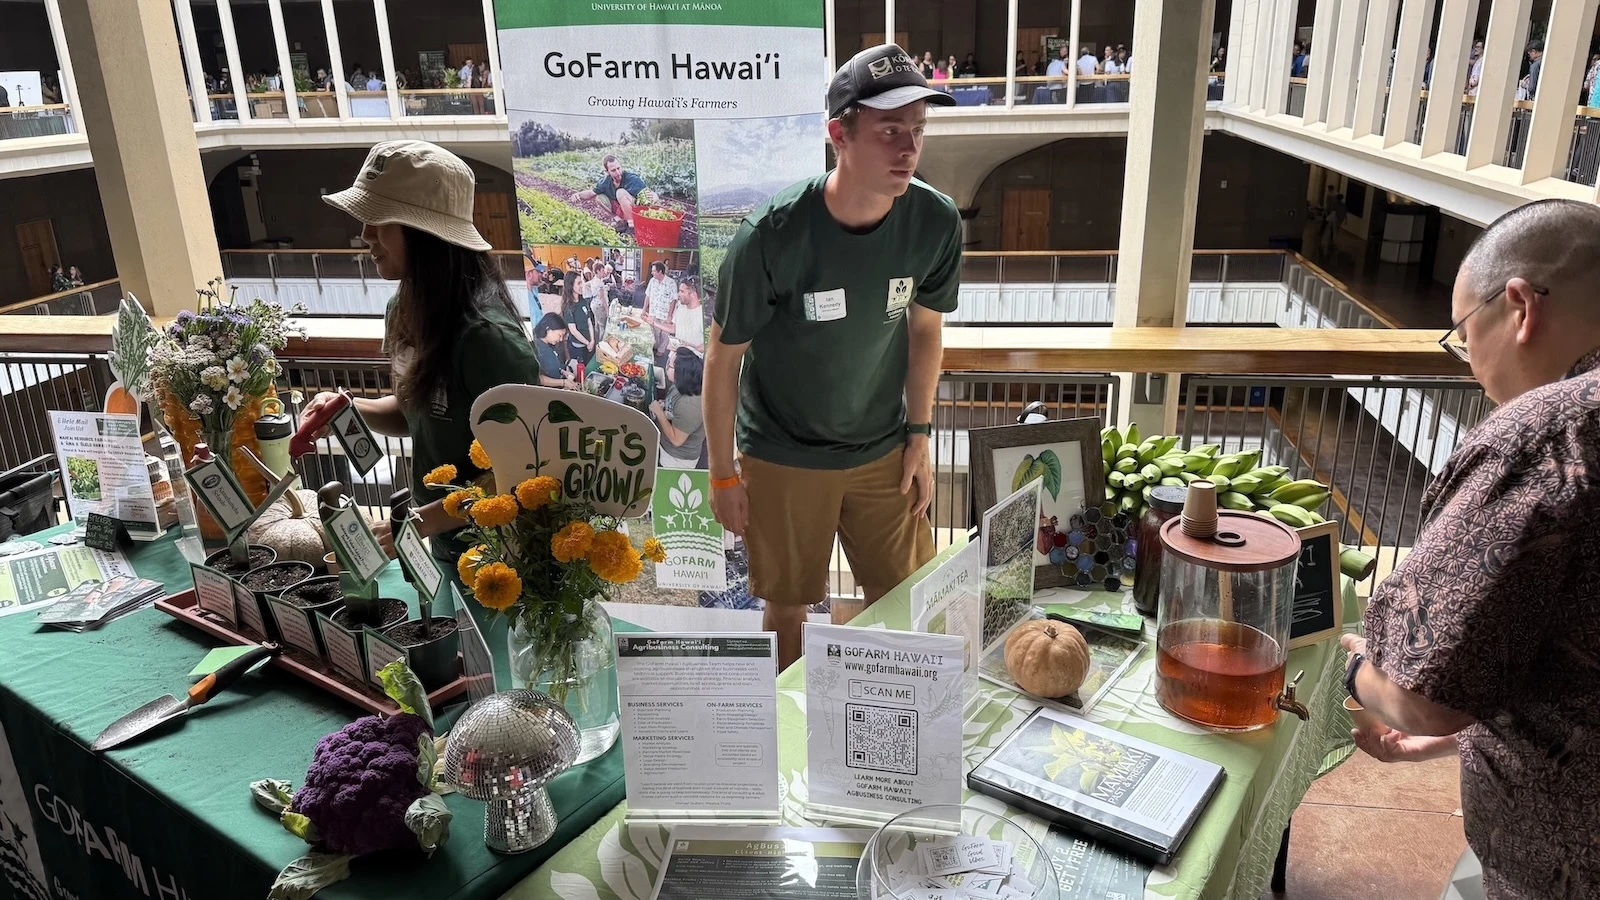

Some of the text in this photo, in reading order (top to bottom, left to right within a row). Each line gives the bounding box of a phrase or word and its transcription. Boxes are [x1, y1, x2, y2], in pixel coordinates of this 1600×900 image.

[544, 52, 780, 80] GoFarm Hawai'i
[588, 96, 634, 110] Growing
[690, 98, 738, 109] Farmers
[559, 424, 646, 466] LET'S
[564, 462, 645, 509] GROW!
[664, 556, 716, 569] GOFARM
[674, 570, 708, 579] HAWAI'I
[956, 570, 968, 586] TEA
[844, 647, 943, 665] GOFARM HAWAI'I
[845, 660, 938, 681] www.gofarmhawaii.org
[864, 686, 912, 699] SCAN ME
[854, 774, 914, 786] LEARN MORE ABOUT
[1108, 754, 1153, 805] PAST & PRESENT
[856, 783, 912, 795] GOFARM HAWAI'I
[846, 790, 922, 805] AGBUSINESS CONSULTING
[34, 783, 150, 896] GOFARM
[962, 842, 985, 851] GoFarm
[968, 849, 983, 857] Good
[1060, 867, 1076, 892] GET
[1070, 839, 1088, 862] FREE
